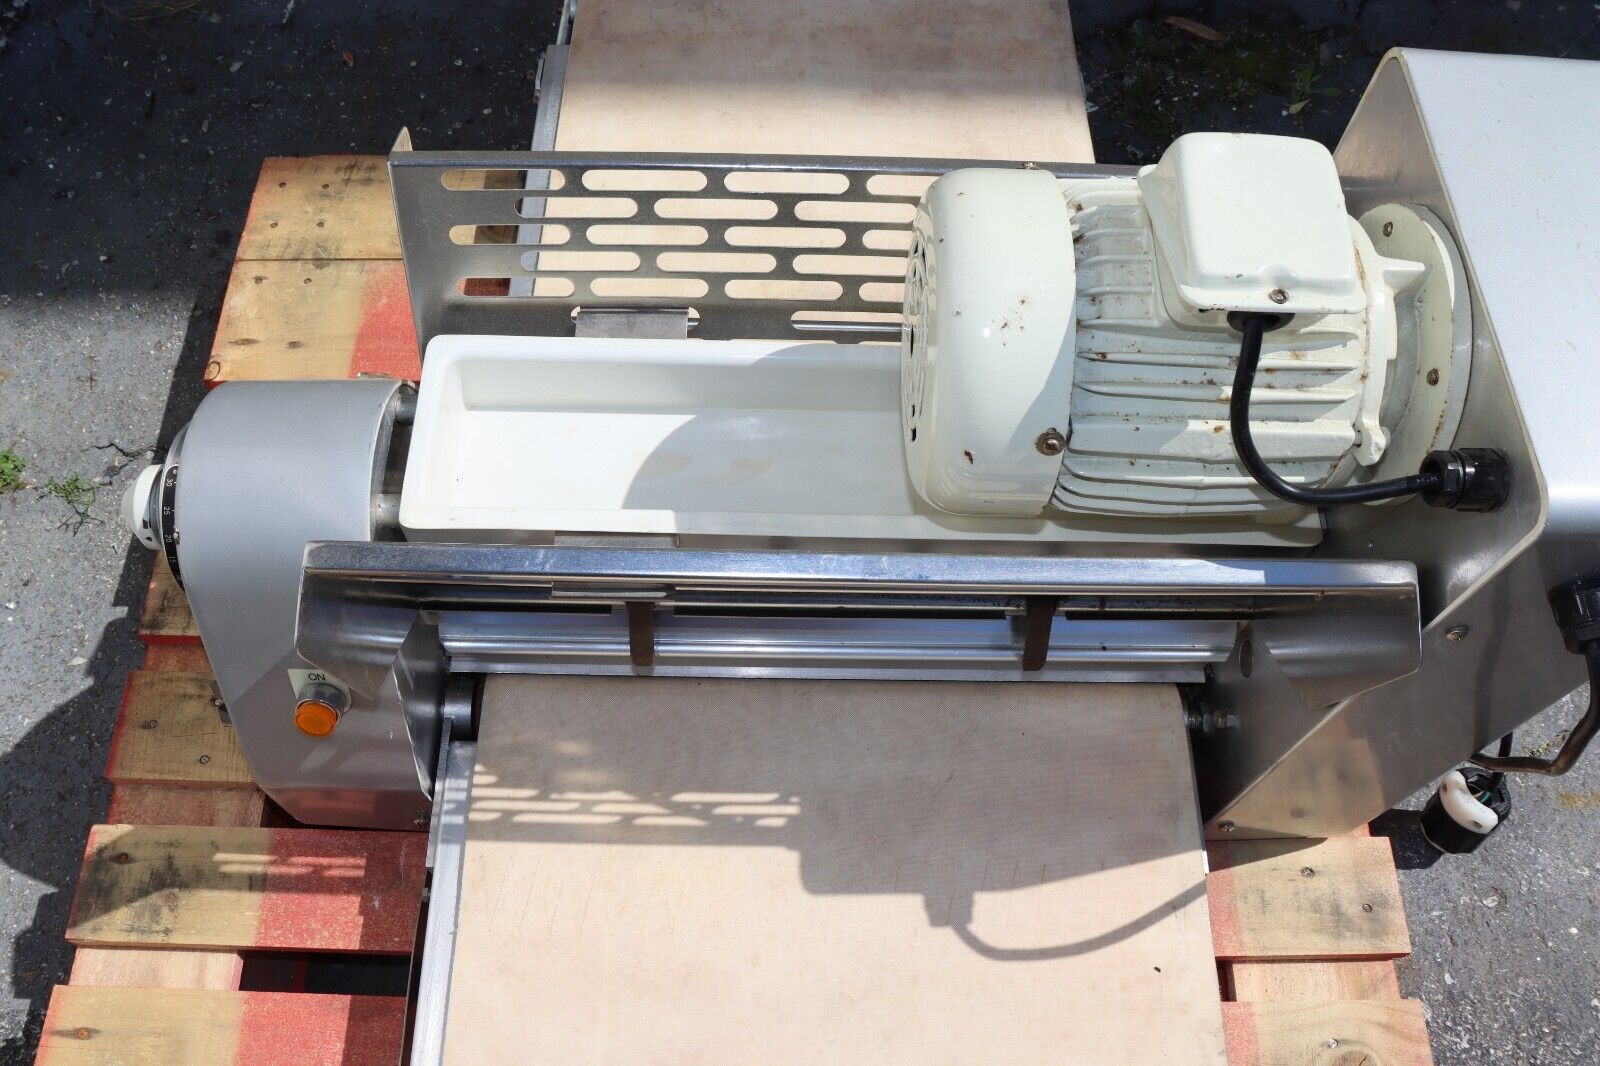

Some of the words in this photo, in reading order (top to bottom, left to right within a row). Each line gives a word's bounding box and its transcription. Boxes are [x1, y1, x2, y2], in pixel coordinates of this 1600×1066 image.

[166, 478, 173, 487] 30
[164, 506, 171, 516] 25
[164, 534, 173, 543] 20
[308, 673, 326, 681] ON
